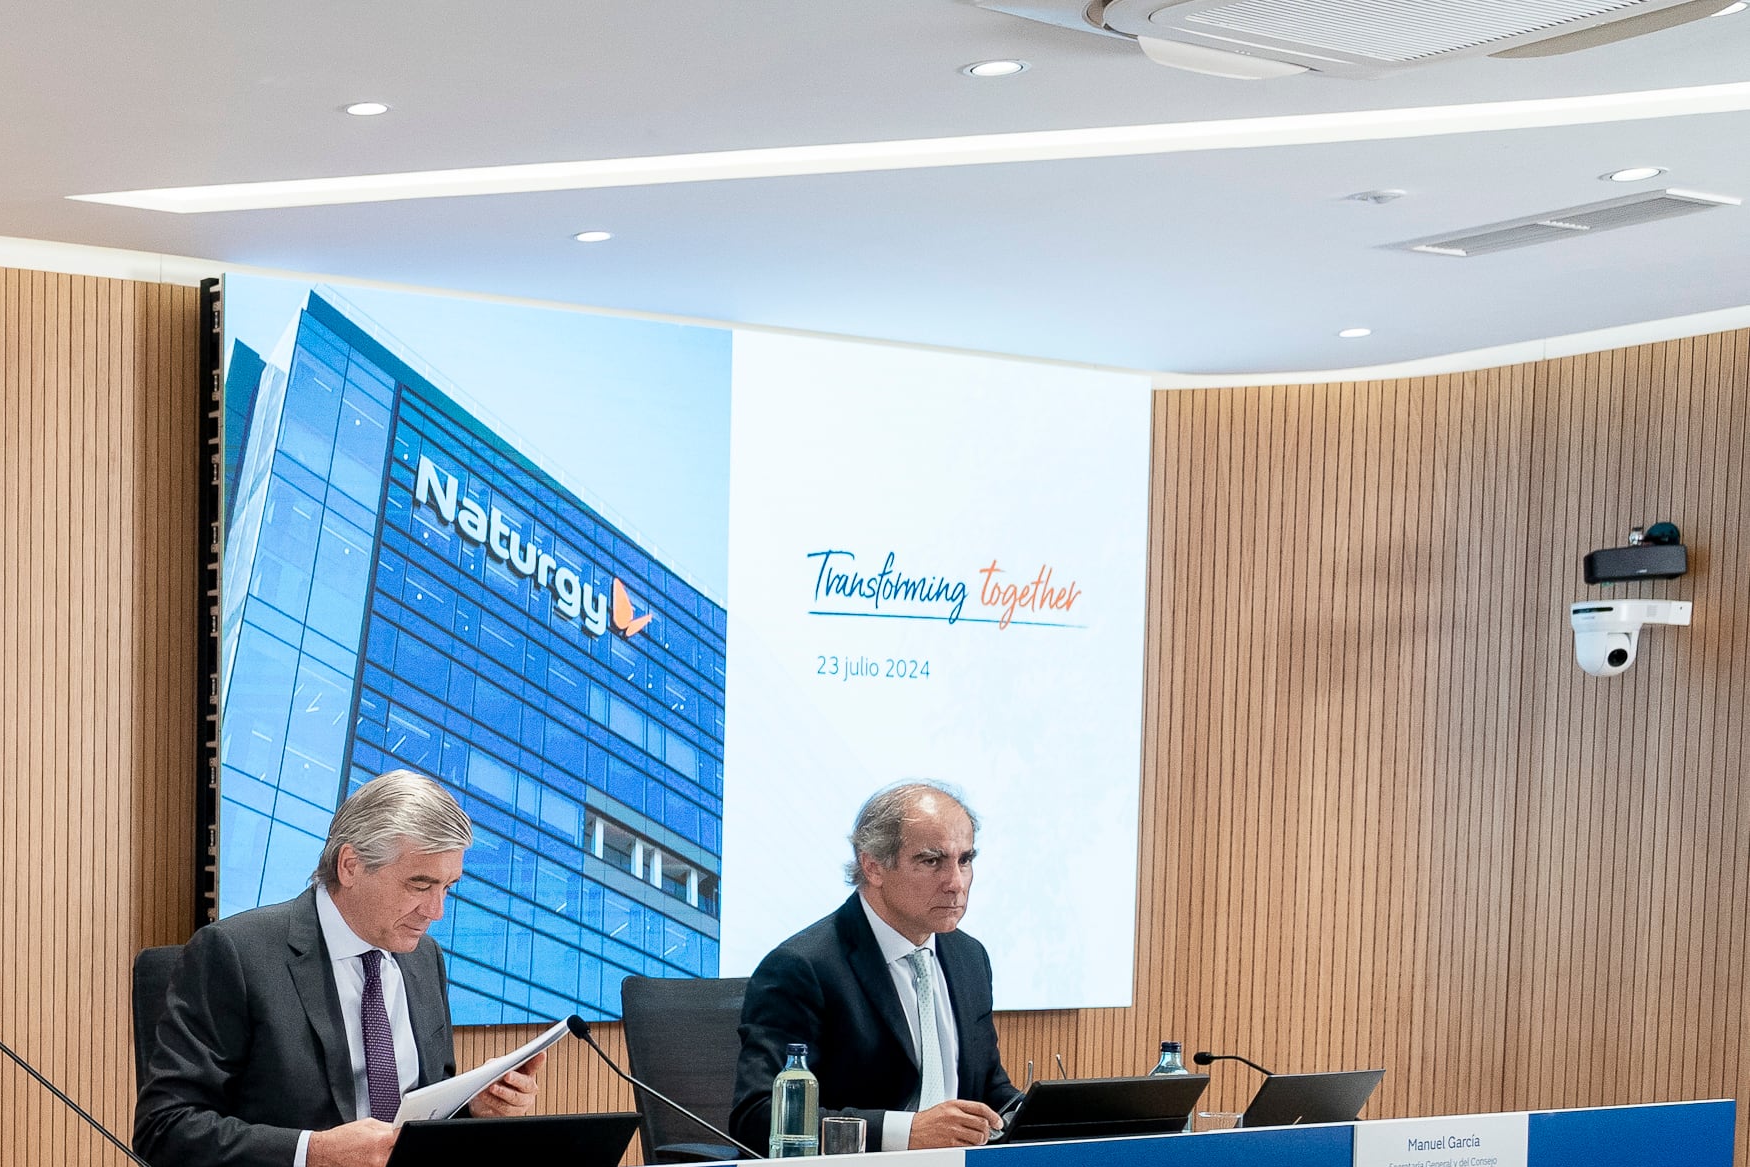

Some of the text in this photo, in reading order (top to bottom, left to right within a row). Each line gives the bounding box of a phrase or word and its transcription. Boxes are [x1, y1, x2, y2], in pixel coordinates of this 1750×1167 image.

[415, 455, 608, 635] Naturgy
[806, 549, 1083, 631] Transforming together
[816, 654, 931, 682] 23 julio 2024
[1408, 1134, 1481, 1151] Manuel García
[1459, 1157, 1470, 1167] del
[1471, 1156, 1498, 1167] Consejo
